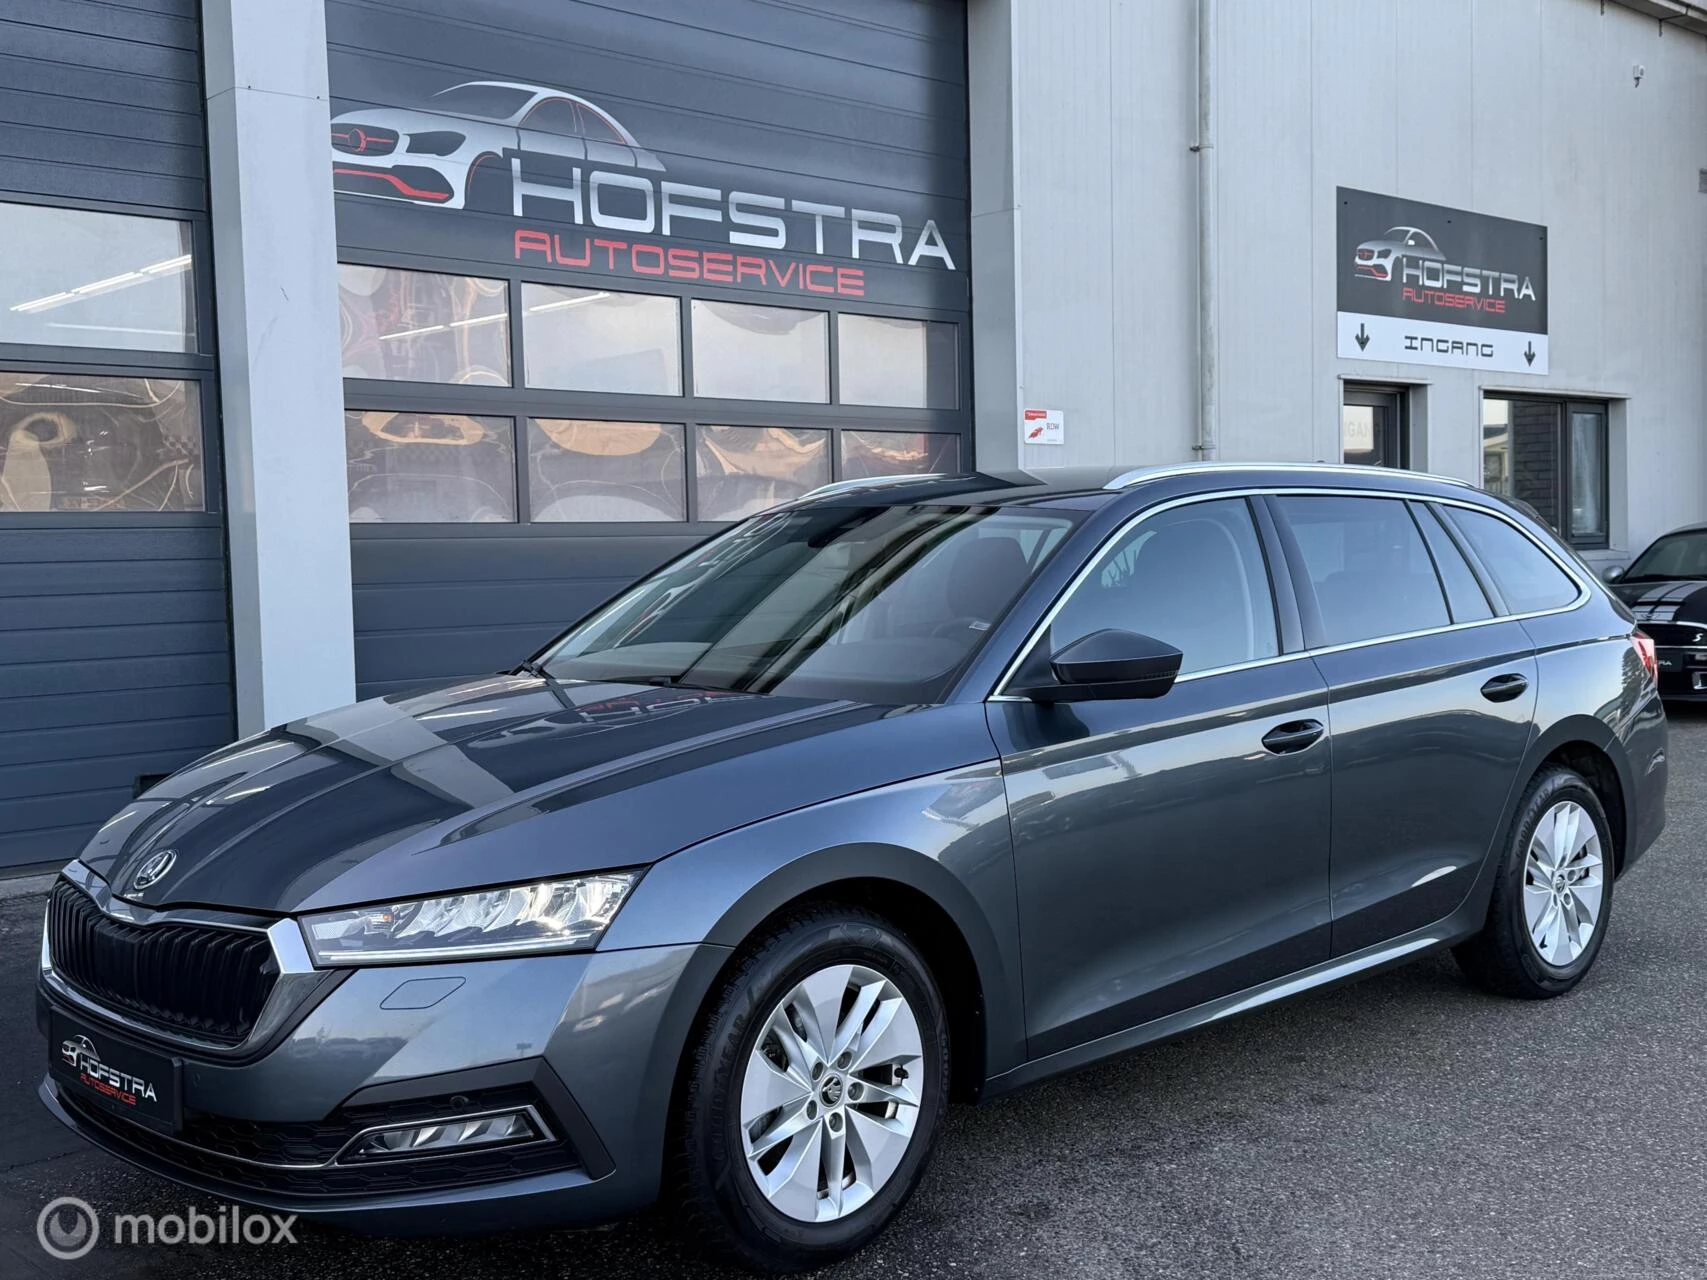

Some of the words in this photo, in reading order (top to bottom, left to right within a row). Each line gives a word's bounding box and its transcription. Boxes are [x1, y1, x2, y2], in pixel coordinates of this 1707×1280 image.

[512, 158, 956, 270] HOFSTRA
[514, 229, 865, 296] AUTOSERVICE
[1402, 258, 1535, 301] HOFSTRA
[1402, 288, 1506, 313] AUTOSERVICE
[1404, 335, 1493, 358] INGANG
[80, 1053, 157, 1102] HOFSTRA
[80, 1072, 137, 1105] AUTOSERVICE
